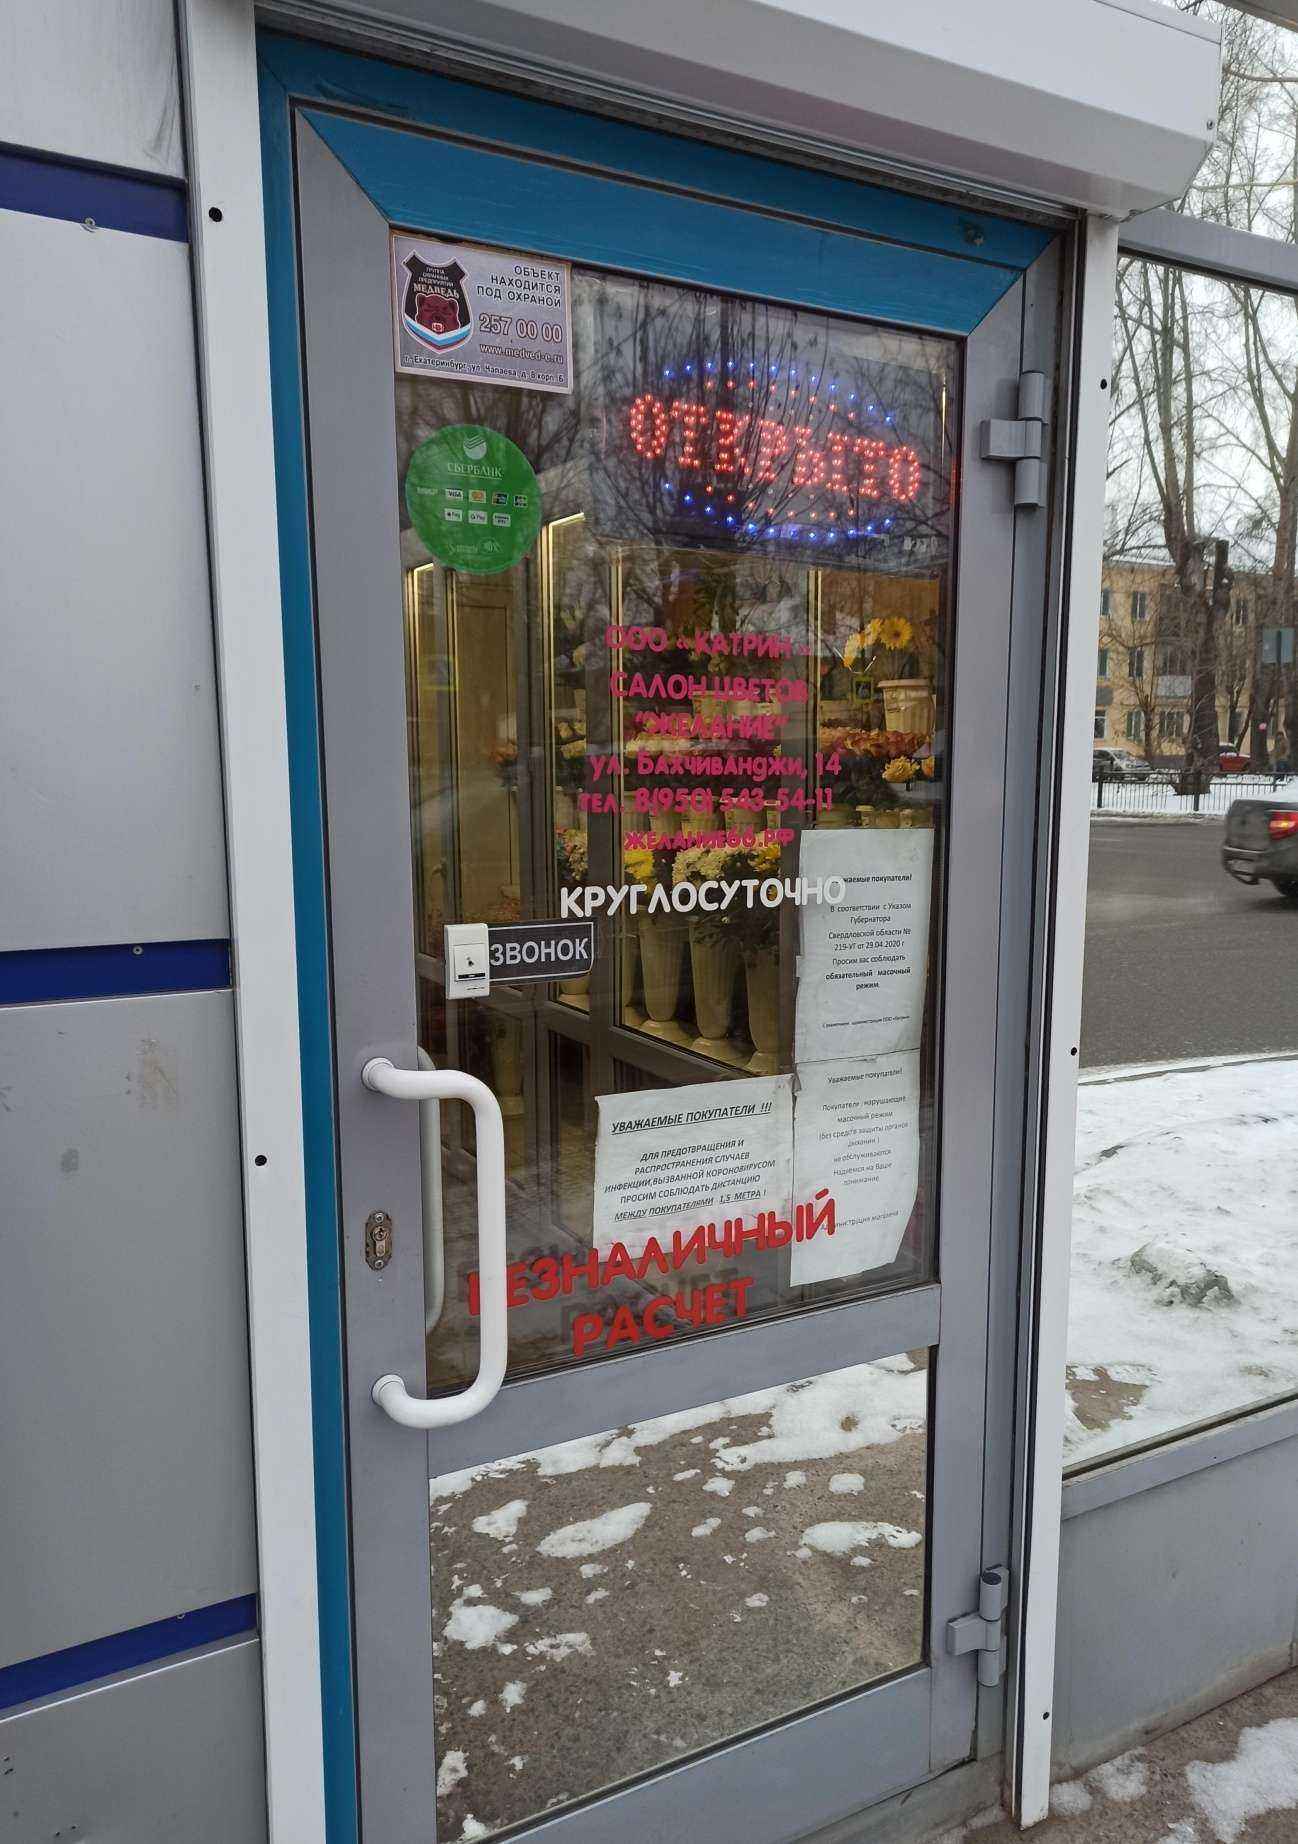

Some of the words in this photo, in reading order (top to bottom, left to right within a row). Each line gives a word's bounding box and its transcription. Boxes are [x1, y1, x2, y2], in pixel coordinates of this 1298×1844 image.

[491, 275, 561, 295] НАХОДИТСЯ
[514, 265, 560, 282] ОБЪЕКТ
[477, 285, 502, 300] ПОД
[507, 291, 561, 308] ОХРАНОЙ
[479, 313, 512, 336] 257
[516, 319, 538, 340] 00
[541, 322, 563, 343] 00
[480, 344, 564, 365] www.medved-c.ru
[629, 392, 921, 501] ОТКРЫТО
[447, 462, 504, 477] СБЕРБАНК
[604, 624, 668, 653] ООО
[610, 671, 708, 700] САЛОН
[713, 675, 810, 705] ЦВЕТОВ
[815, 751, 843, 777] 14
[635, 786, 713, 817] 8(950)
[719, 786, 833, 817] 543-54-11
[871, 873, 913, 884] покупатели!
[561, 875, 847, 918] КРУГЛОСУТОЧНО
[837, 904, 880, 912] соответствии
[888, 902, 912, 911] Указом
[850, 915, 891, 925] Губернатора
[828, 929, 875, 939] Свердловской
[875, 927, 902, 937] области
[489, 936, 590, 967] ЗВОНОК
[832, 957, 858, 966] Просим
[870, 954, 906, 963] соблюдать
[825, 970, 873, 980] обязательный
[877, 966, 912, 976] масочный
[827, 1073, 864, 1084] Уважаемые
[611, 1112, 684, 1133] УВАЖАЕМЫЕ
[685, 1103, 756, 1123] ПОКУПАТЕЛИ
[759, 1101, 773, 1113] !!!
[639, 1151, 660, 1163] ДЛЯ
[660, 1141, 737, 1159] ПРЕДОТВРАЩЕНИЯ
[738, 1139, 745, 1148] И
[634, 1156, 714, 1176] РАСПРОСТРАНЕНИЯ
[714, 1151, 751, 1164] СЛУЧАЕВ
[706, 1159, 776, 1178] КОРОНОВИРУСОМ
[620, 1192, 657, 1205] ПРОСИМ
[658, 1183, 710, 1200] СОБЛЮДАТЬ
[710, 1174, 761, 1191] ДИСТАНЦИЮ
[614, 1208, 647, 1222] МЕЖДУ
[647, 1198, 714, 1217] ПОКУПАТЕЛЯМИ
[733, 1189, 762, 1201] МЕТРА
[572, 1275, 755, 1358] РАСЧЕТ
